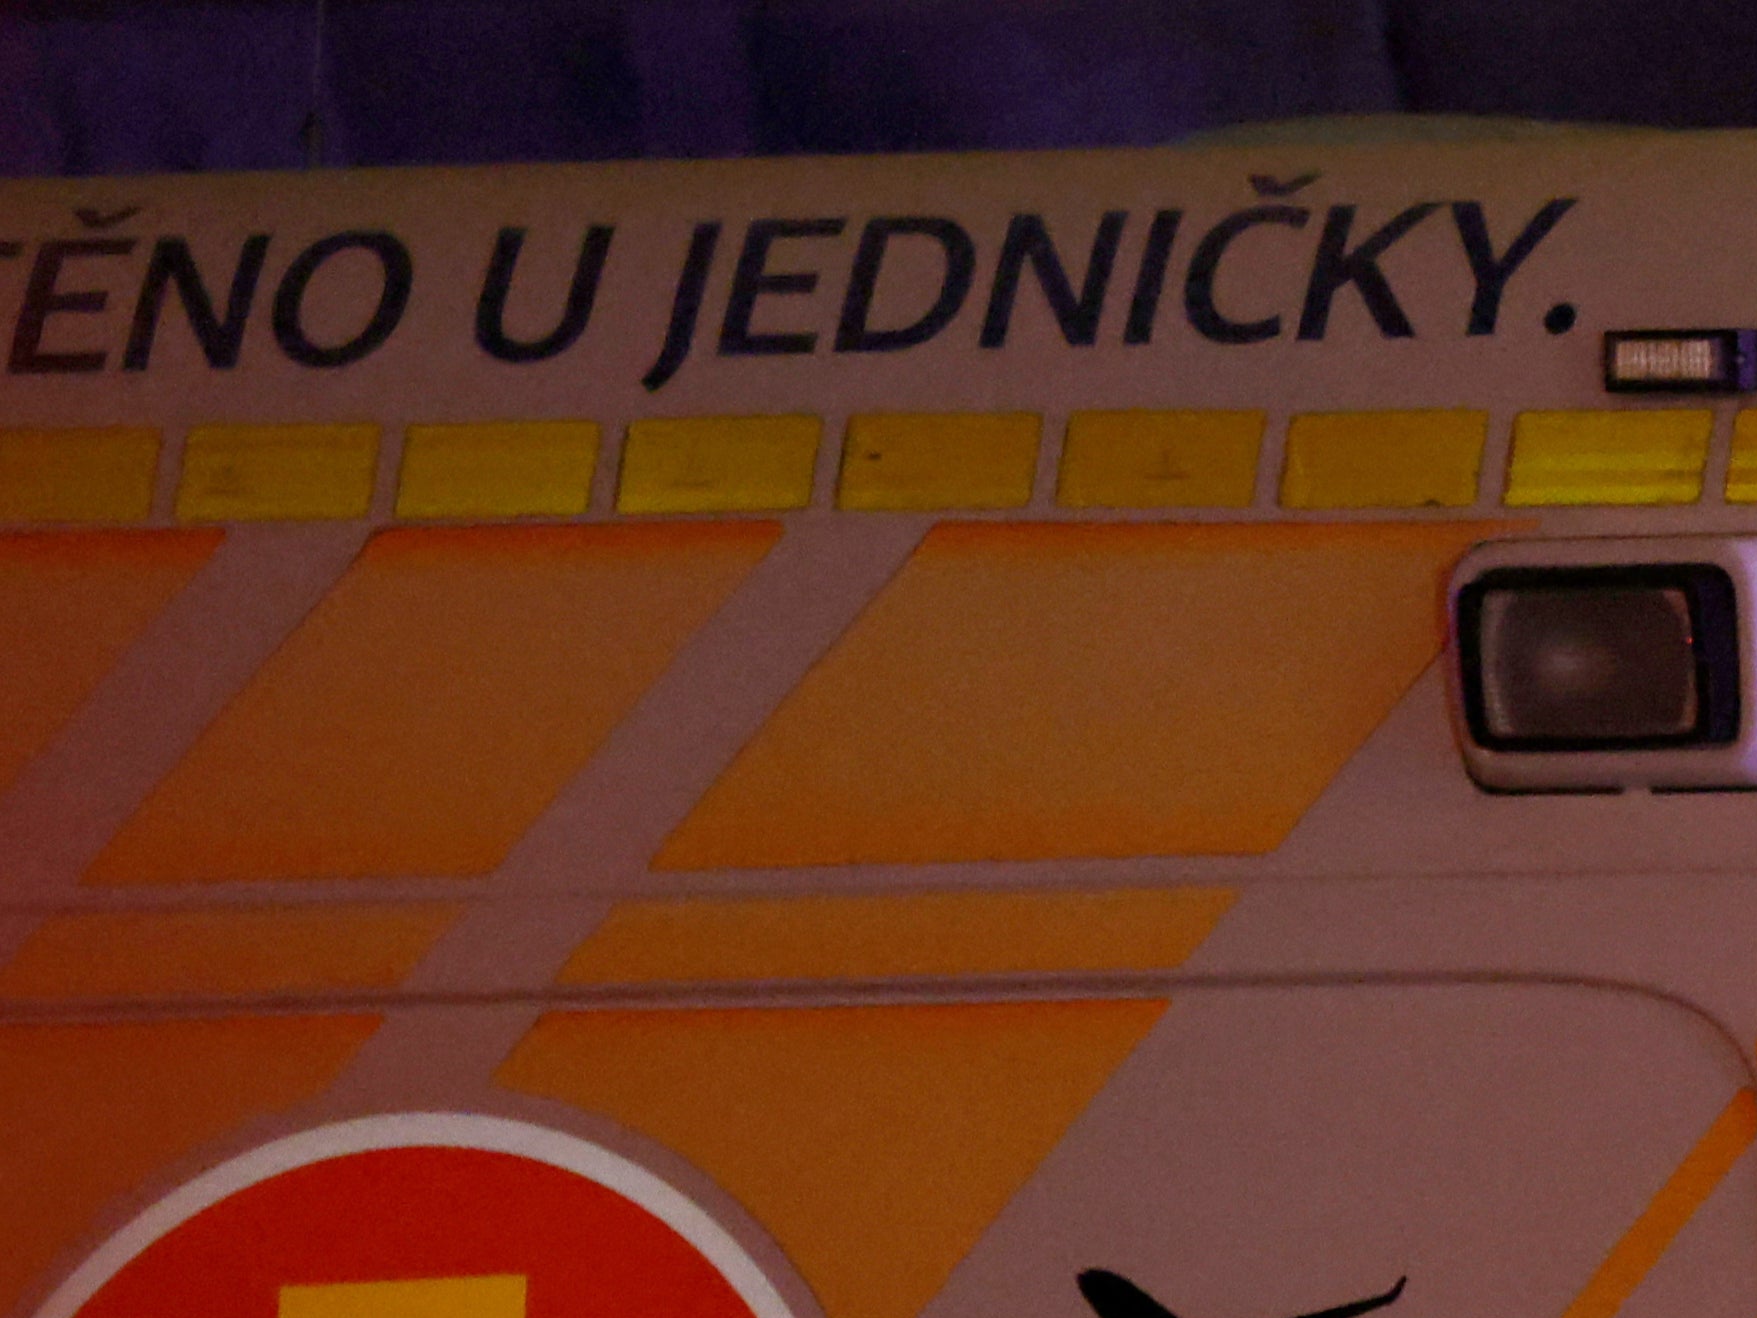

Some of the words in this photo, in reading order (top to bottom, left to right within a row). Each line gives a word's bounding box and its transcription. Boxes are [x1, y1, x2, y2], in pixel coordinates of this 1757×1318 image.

[0, 205, 413, 373] ĚNO
[475, 225, 607, 363] U
[644, 174, 1579, 391] JEDNIČKY.
